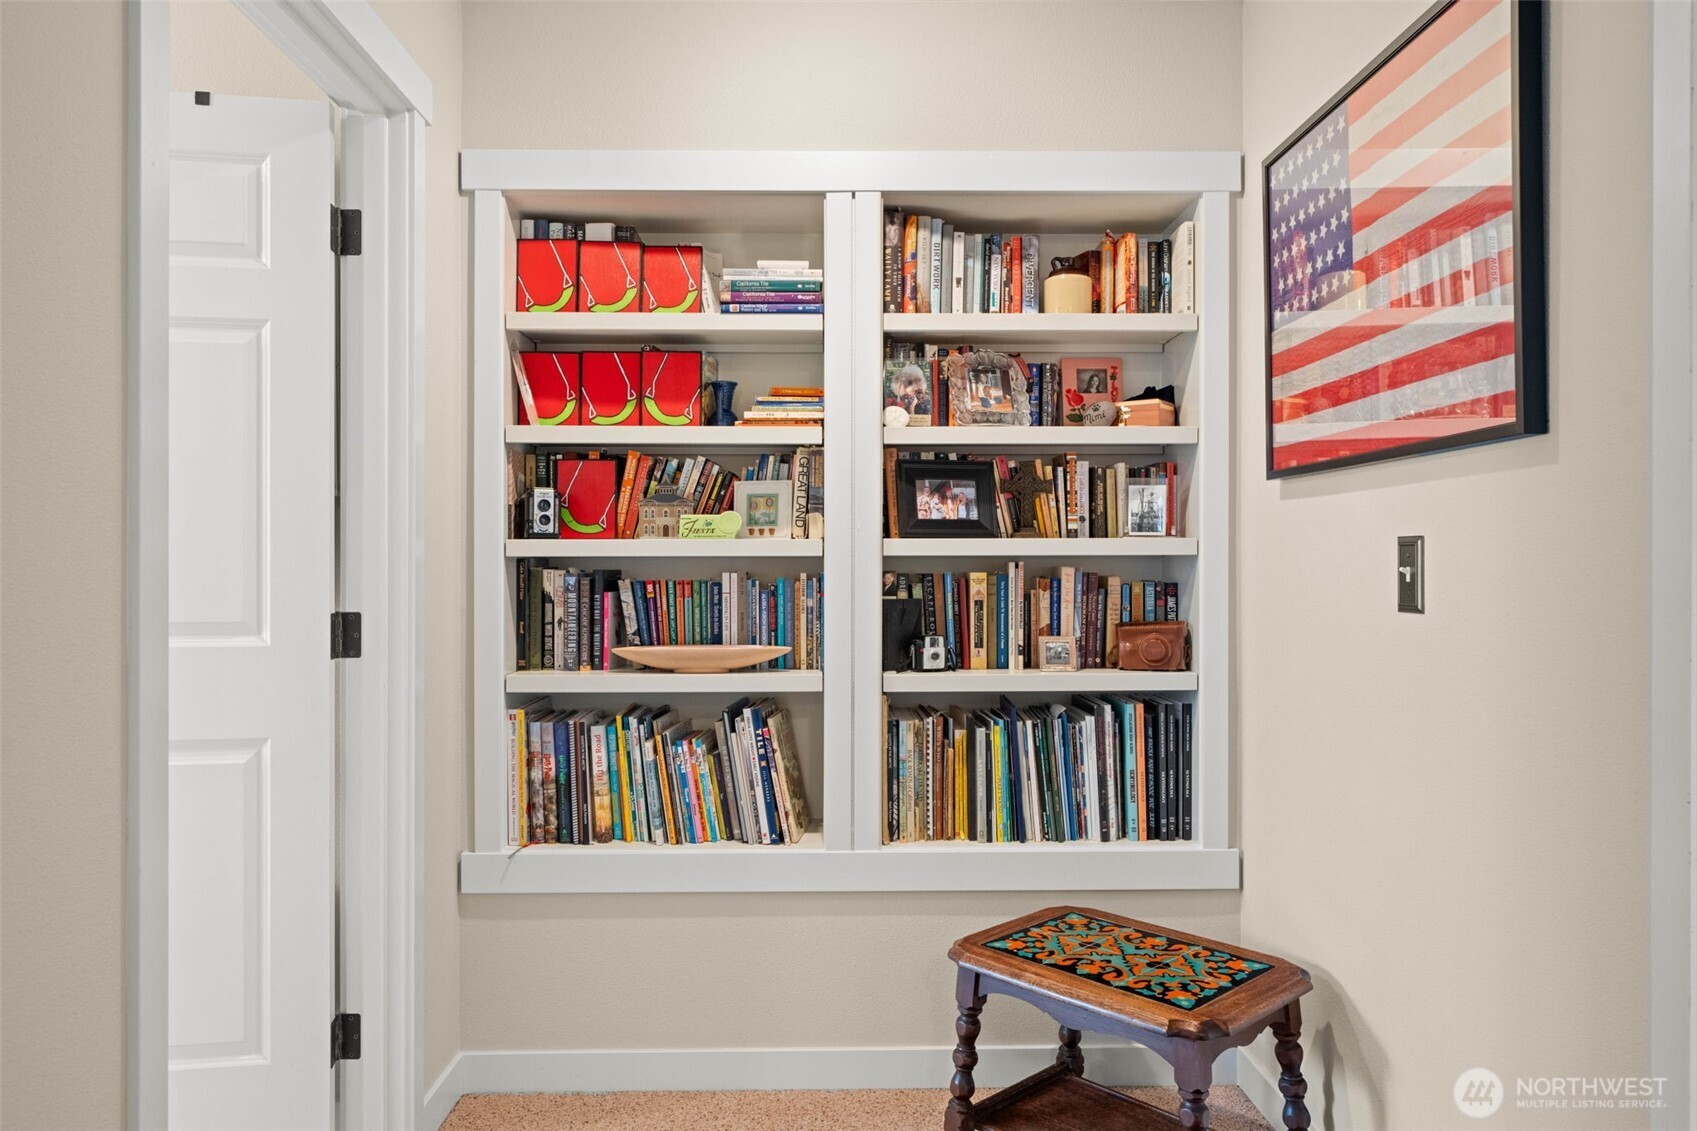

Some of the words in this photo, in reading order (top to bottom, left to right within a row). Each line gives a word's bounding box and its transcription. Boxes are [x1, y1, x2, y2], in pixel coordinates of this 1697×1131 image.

[1025, 253, 1035, 308] DIVERGENT
[1083, 410, 1106, 424] Mimi
[797, 456, 809, 494] GREAT
[795, 496, 806, 528] LAND
[1167, 596, 1177, 611] JAMES
[568, 592, 576, 652] MOUNTAINEERING
[756, 728, 766, 755] TILE
